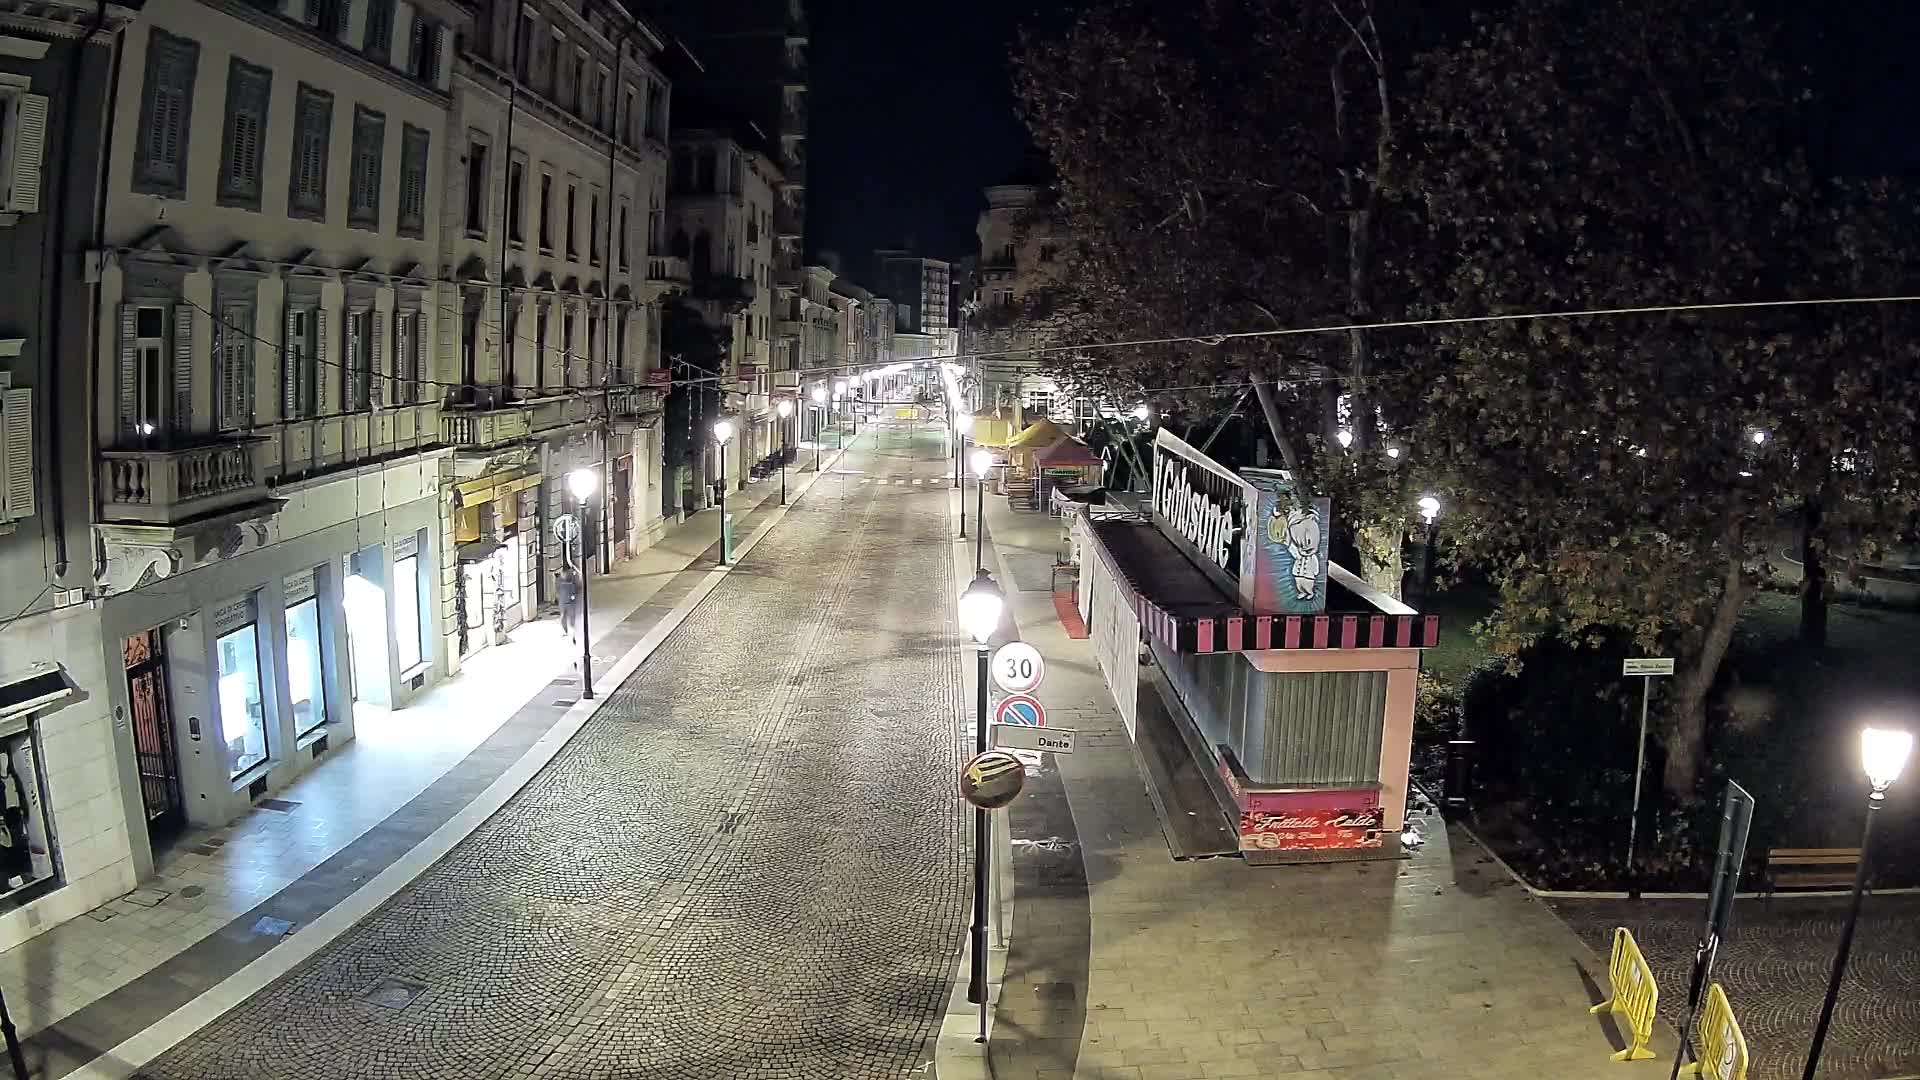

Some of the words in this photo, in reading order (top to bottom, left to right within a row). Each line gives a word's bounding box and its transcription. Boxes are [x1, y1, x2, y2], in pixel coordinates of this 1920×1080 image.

[1162, 458, 1233, 569] Golosone
[1006, 658, 1032, 679] 30
[1038, 737, 1069, 749] Dante
